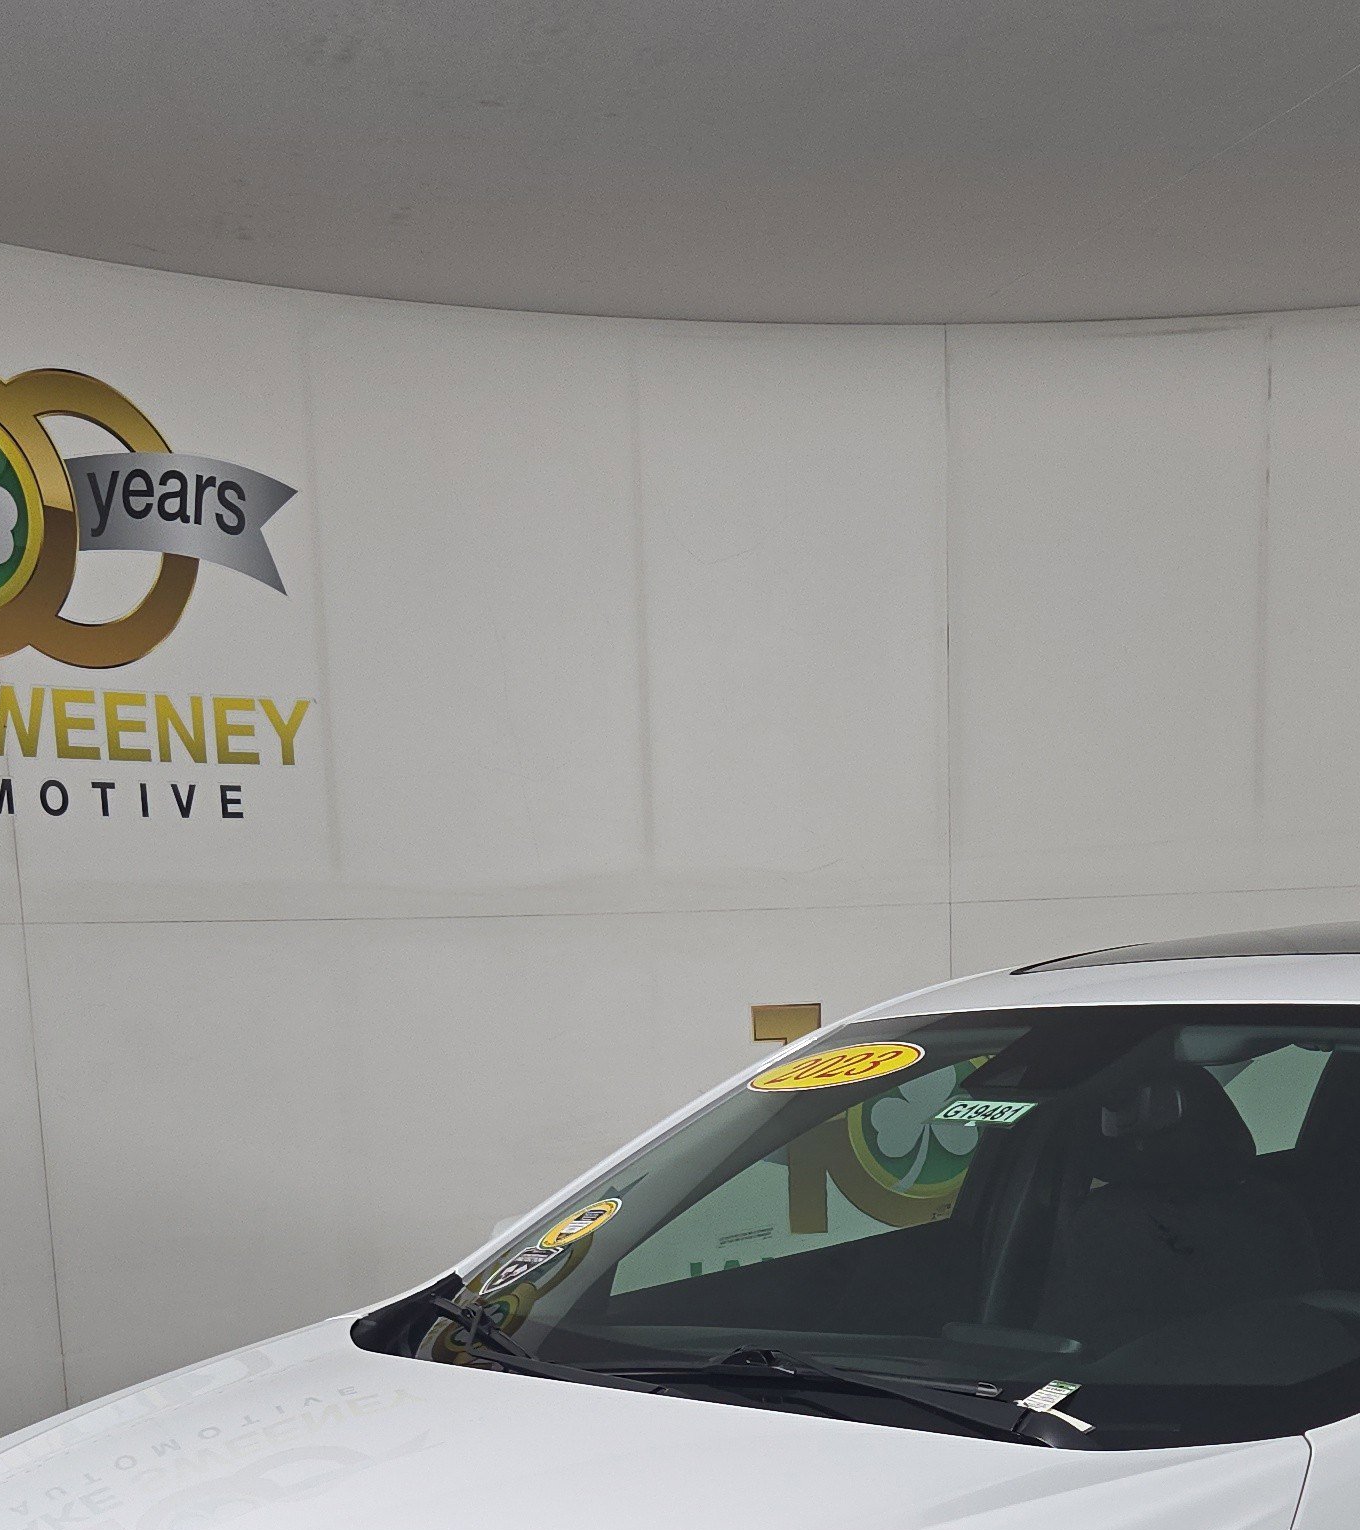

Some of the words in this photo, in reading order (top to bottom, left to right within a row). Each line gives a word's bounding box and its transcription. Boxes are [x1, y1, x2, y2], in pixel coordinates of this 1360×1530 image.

[87, 469, 247, 537] years
[763, 1050, 903, 1085] 2023
[943, 1104, 1024, 1121] G19481
